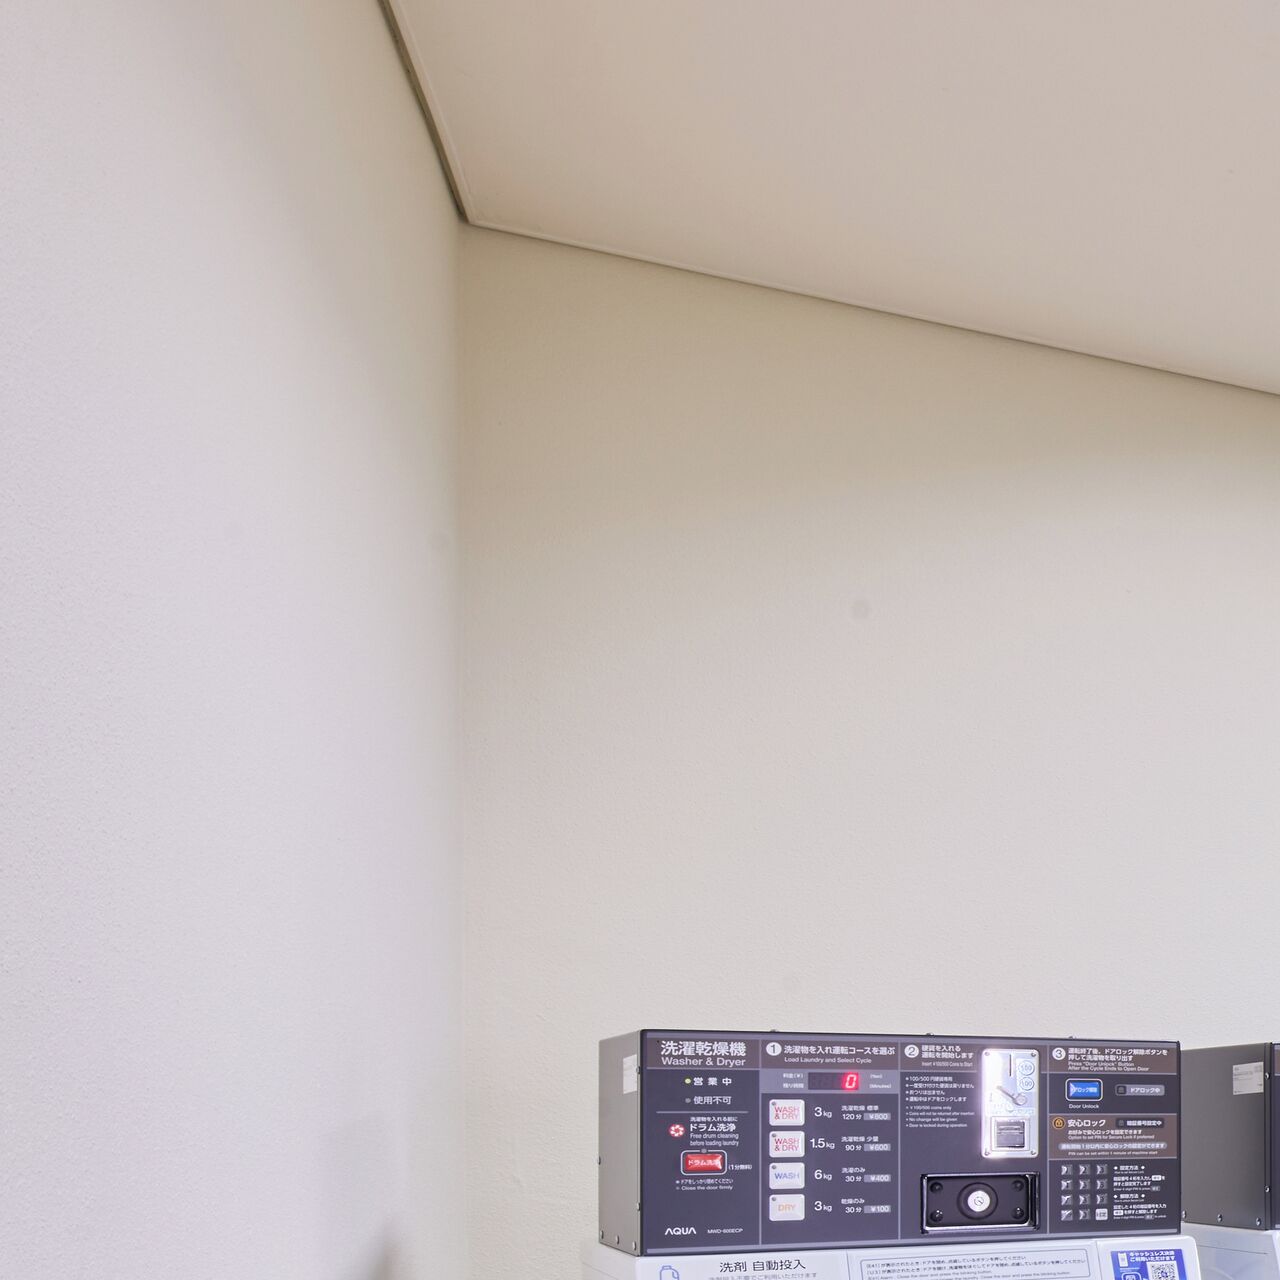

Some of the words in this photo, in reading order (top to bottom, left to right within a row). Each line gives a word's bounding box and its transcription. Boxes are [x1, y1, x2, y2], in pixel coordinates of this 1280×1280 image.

[661, 1041, 746, 1056] 洗濯乾燥機
[784, 1045, 896, 1055] 洗濯物を入れ運転コースを選ぶ
[662, 1057, 702, 1065] Washer
[706, 1058, 713, 1066] &
[717, 1058, 746, 1067] Dryer
[694, 1078, 732, 1086] 営業中
[845, 1074, 857, 1089] 0
[694, 1096, 732, 1105] 使用不可
[690, 1124, 736, 1132] ドラム洗浄
[665, 1227, 697, 1235] AQUA
[720, 1261, 747, 1273] 洗剤
[752, 1260, 806, 1272] 自動投入
